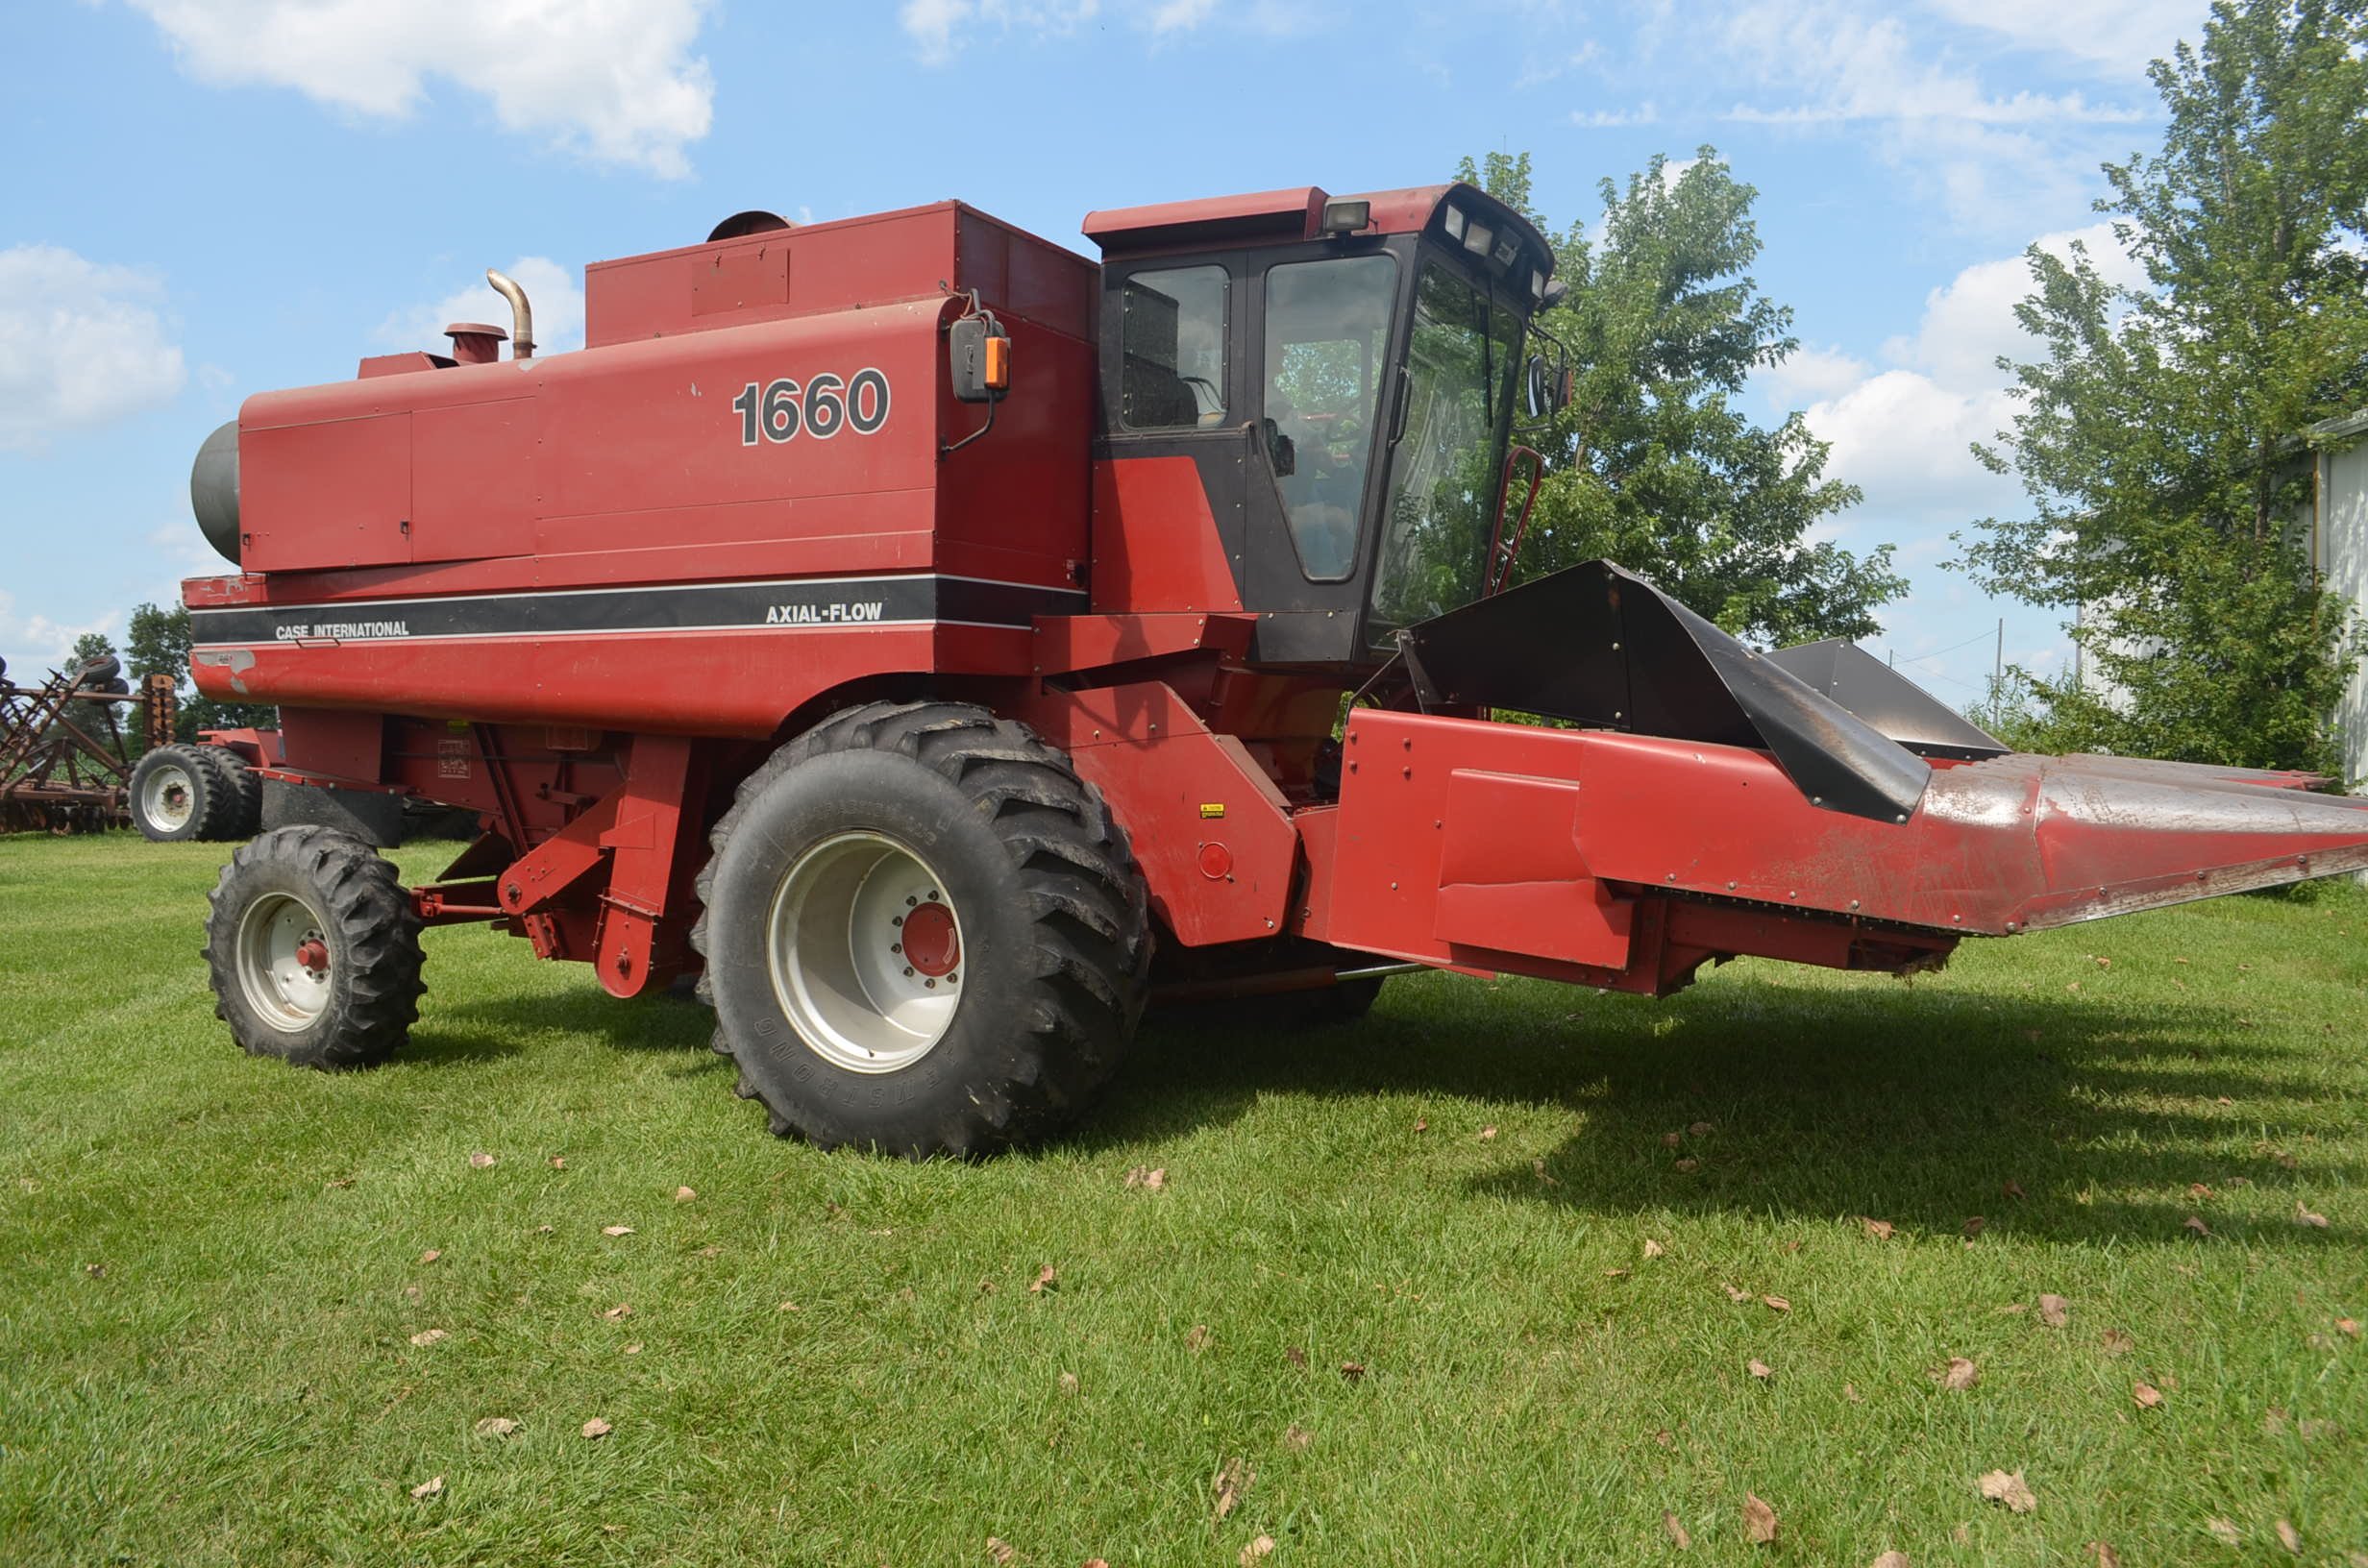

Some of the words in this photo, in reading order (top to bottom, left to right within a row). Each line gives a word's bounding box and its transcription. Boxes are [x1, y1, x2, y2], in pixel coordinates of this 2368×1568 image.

[732, 367, 891, 447] 1660
[766, 602, 882, 624] AXIAL-FLOW
[276, 625, 308, 640] CASE
[313, 622, 409, 638] INTERNATIONAL
